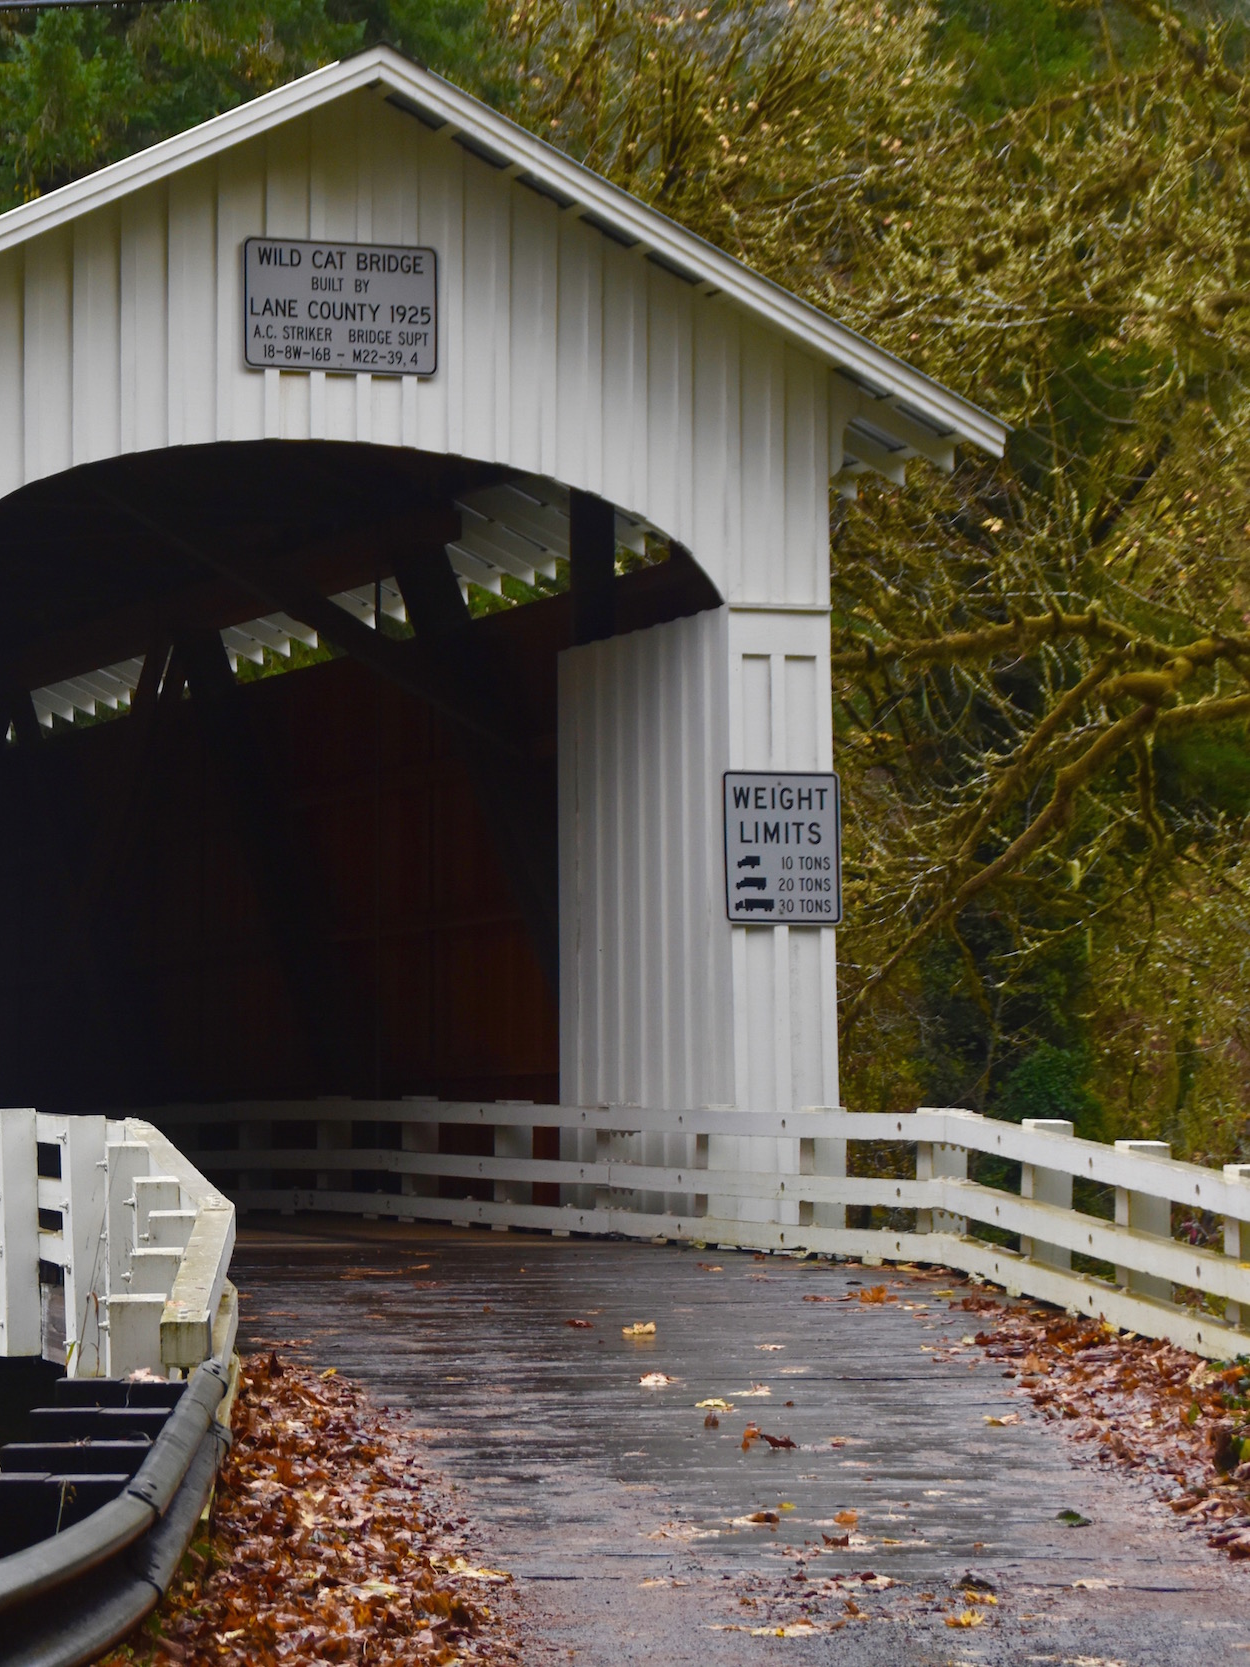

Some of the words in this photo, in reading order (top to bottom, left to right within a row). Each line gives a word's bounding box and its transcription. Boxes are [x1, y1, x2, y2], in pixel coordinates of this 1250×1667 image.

[258, 247, 301, 267] WILD
[312, 250, 346, 270] CAT
[356, 252, 424, 274] BRIDGE
[311, 277, 344, 292] BUILT
[355, 279, 370, 293] BY
[250, 297, 298, 318] LANE
[308, 301, 380, 322] COUNTY
[390, 305, 431, 325] 1925
[253, 325, 277, 340] A.C.
[283, 326, 332, 341] STRIKER
[349, 329, 392, 345] BRIDGE
[398, 331, 429, 346] SUPT
[733, 786, 828, 810] WEIGHT
[740, 821, 822, 845] LIMITS
[781, 856, 793, 870] 10
[799, 856, 831, 871] TONS
[778, 878, 794, 892] 20
[799, 878, 831, 892] TONS
[779, 899, 794, 913] 30
[799, 899, 832, 913] TONS
